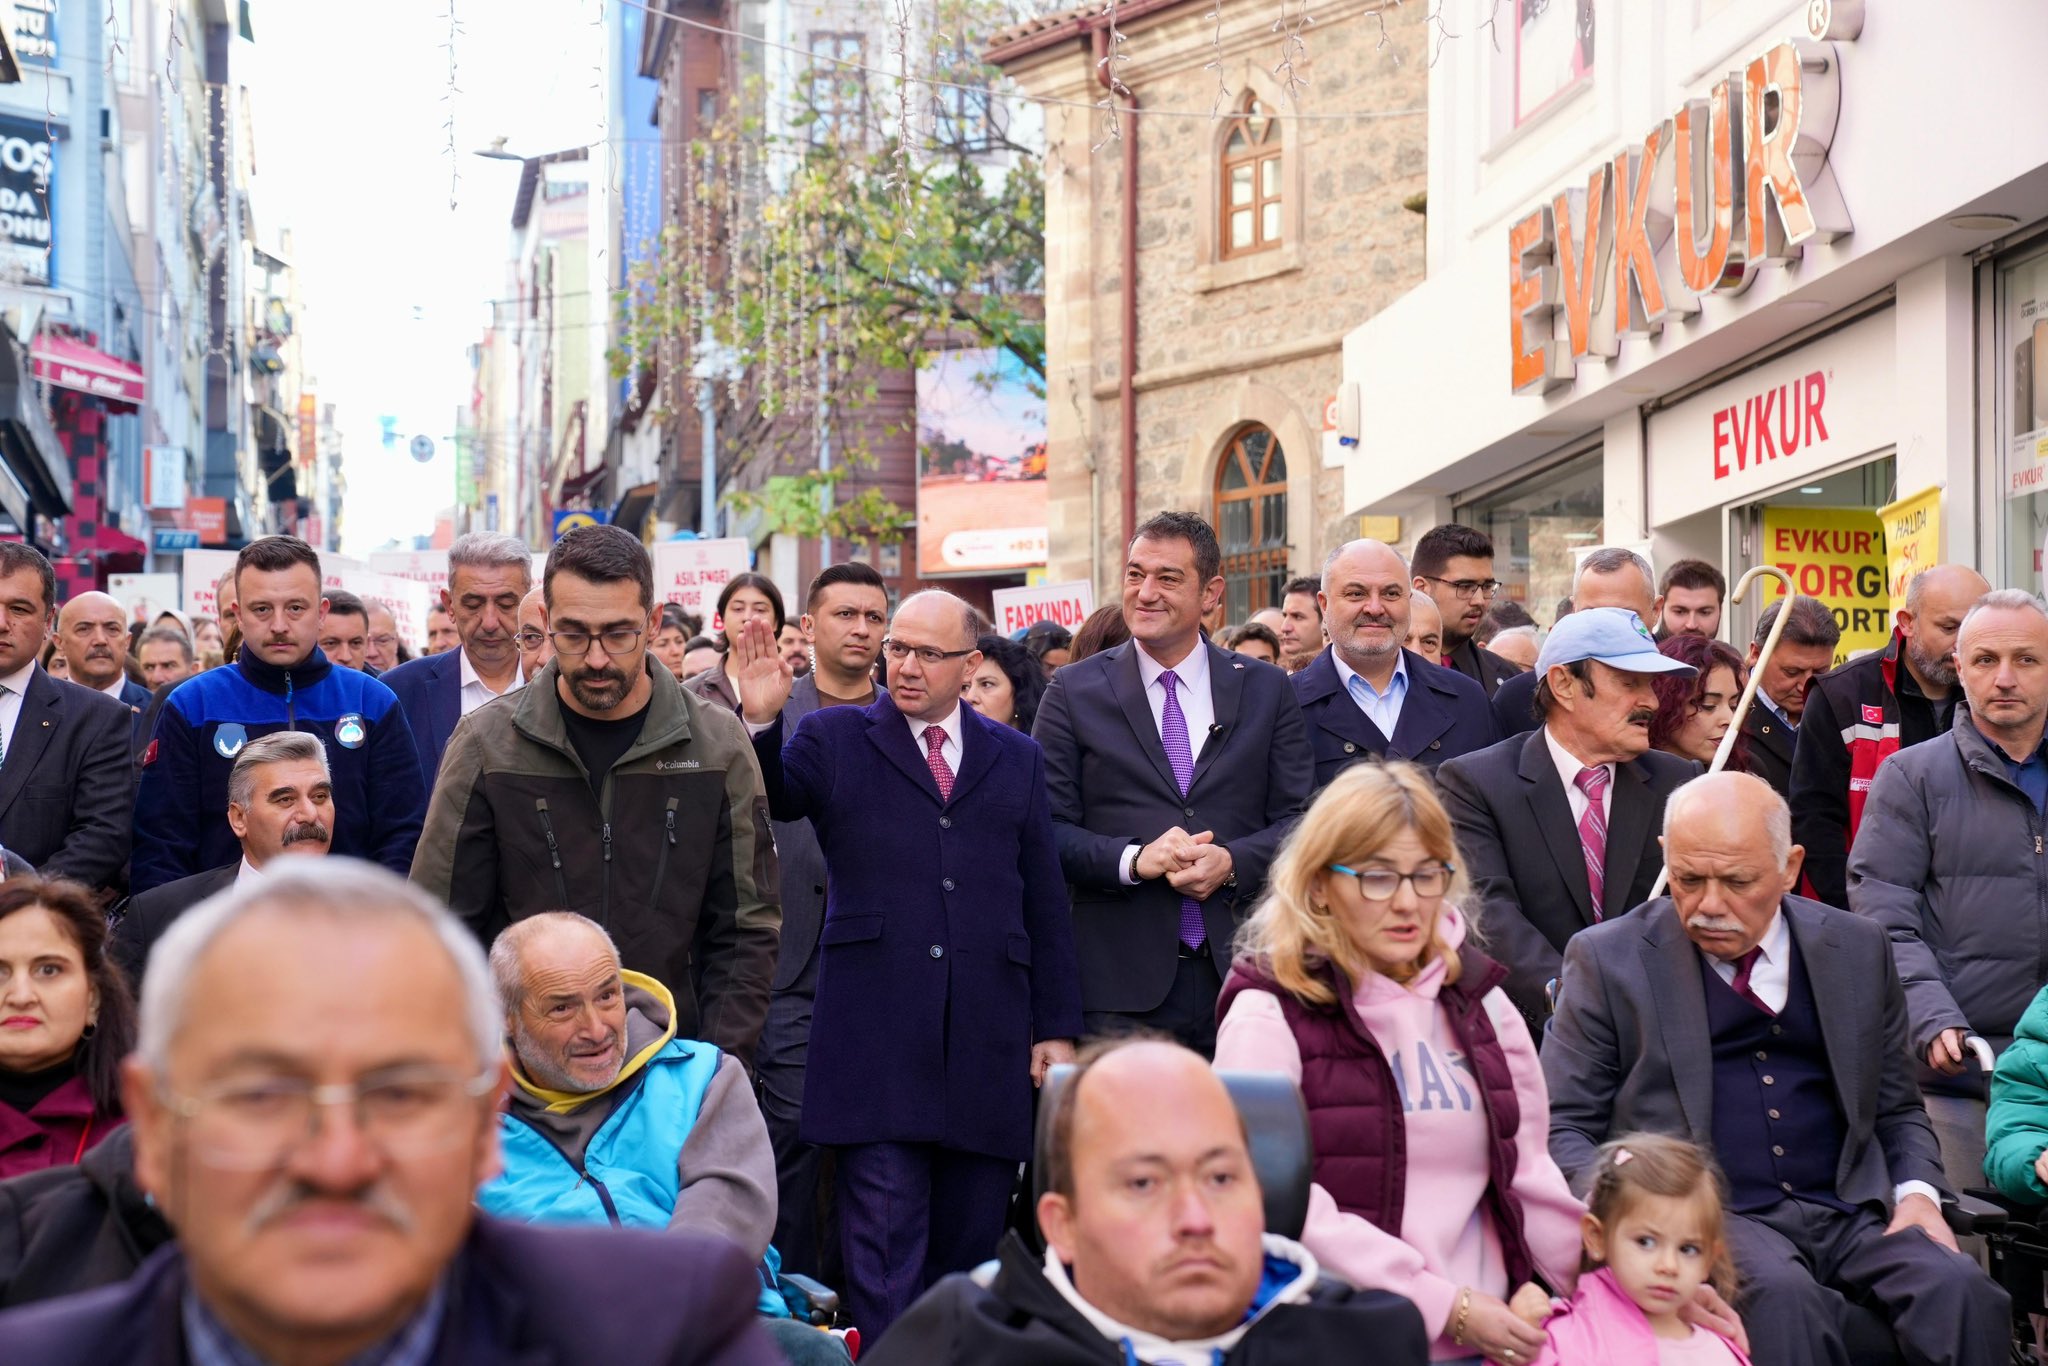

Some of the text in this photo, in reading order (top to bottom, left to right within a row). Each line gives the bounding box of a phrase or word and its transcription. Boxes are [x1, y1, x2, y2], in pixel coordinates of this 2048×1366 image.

[1509, 36, 1816, 394] EVKUR
[1713, 370, 1829, 481] EVKUR
[2013, 465, 2043, 488] EVKUR
[1776, 528, 1887, 555] EVKUR'
[1005, 598, 1084, 633] FARKINDA
[664, 760, 700, 769] Columbia
